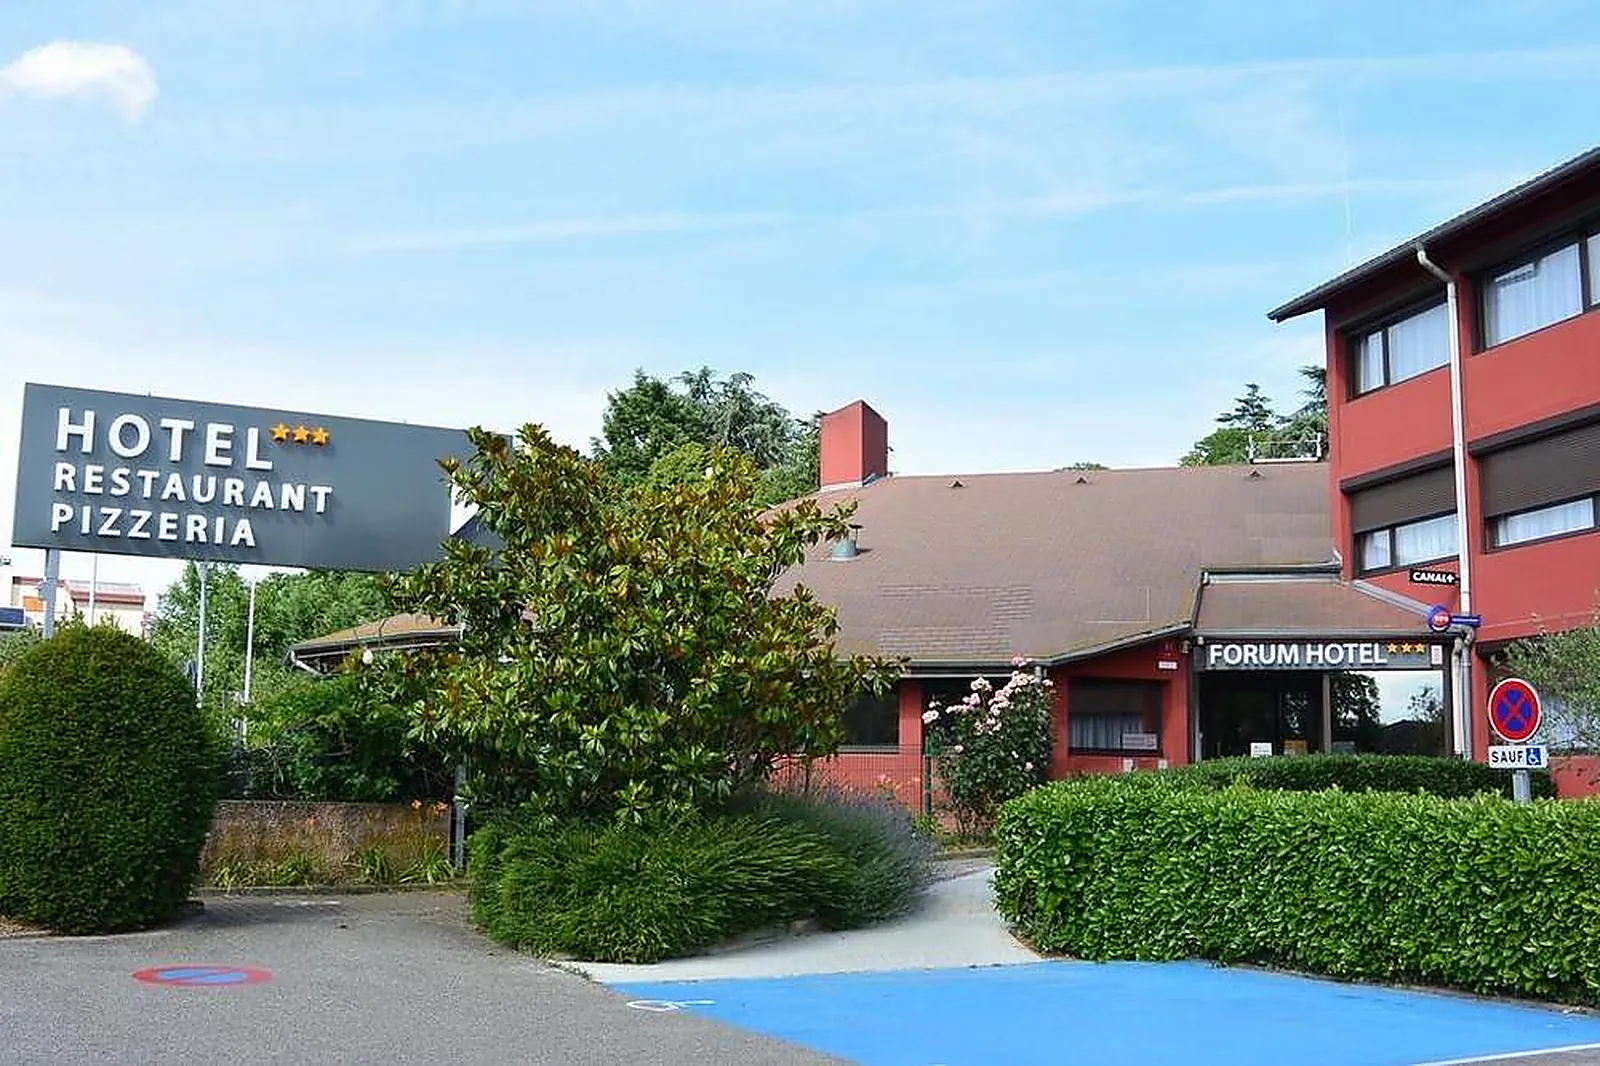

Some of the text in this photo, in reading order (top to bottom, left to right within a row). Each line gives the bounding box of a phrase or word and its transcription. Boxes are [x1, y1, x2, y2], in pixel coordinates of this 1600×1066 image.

[56, 407, 273, 470] HOTEL
[54, 462, 332, 513] RESTAURANT
[51, 503, 255, 546] PIZZERIA
[1412, 571, 1455, 583] CANAL+
[1210, 642, 1388, 665] FORUM HOTEL
[1491, 750, 1524, 763] SAUF
